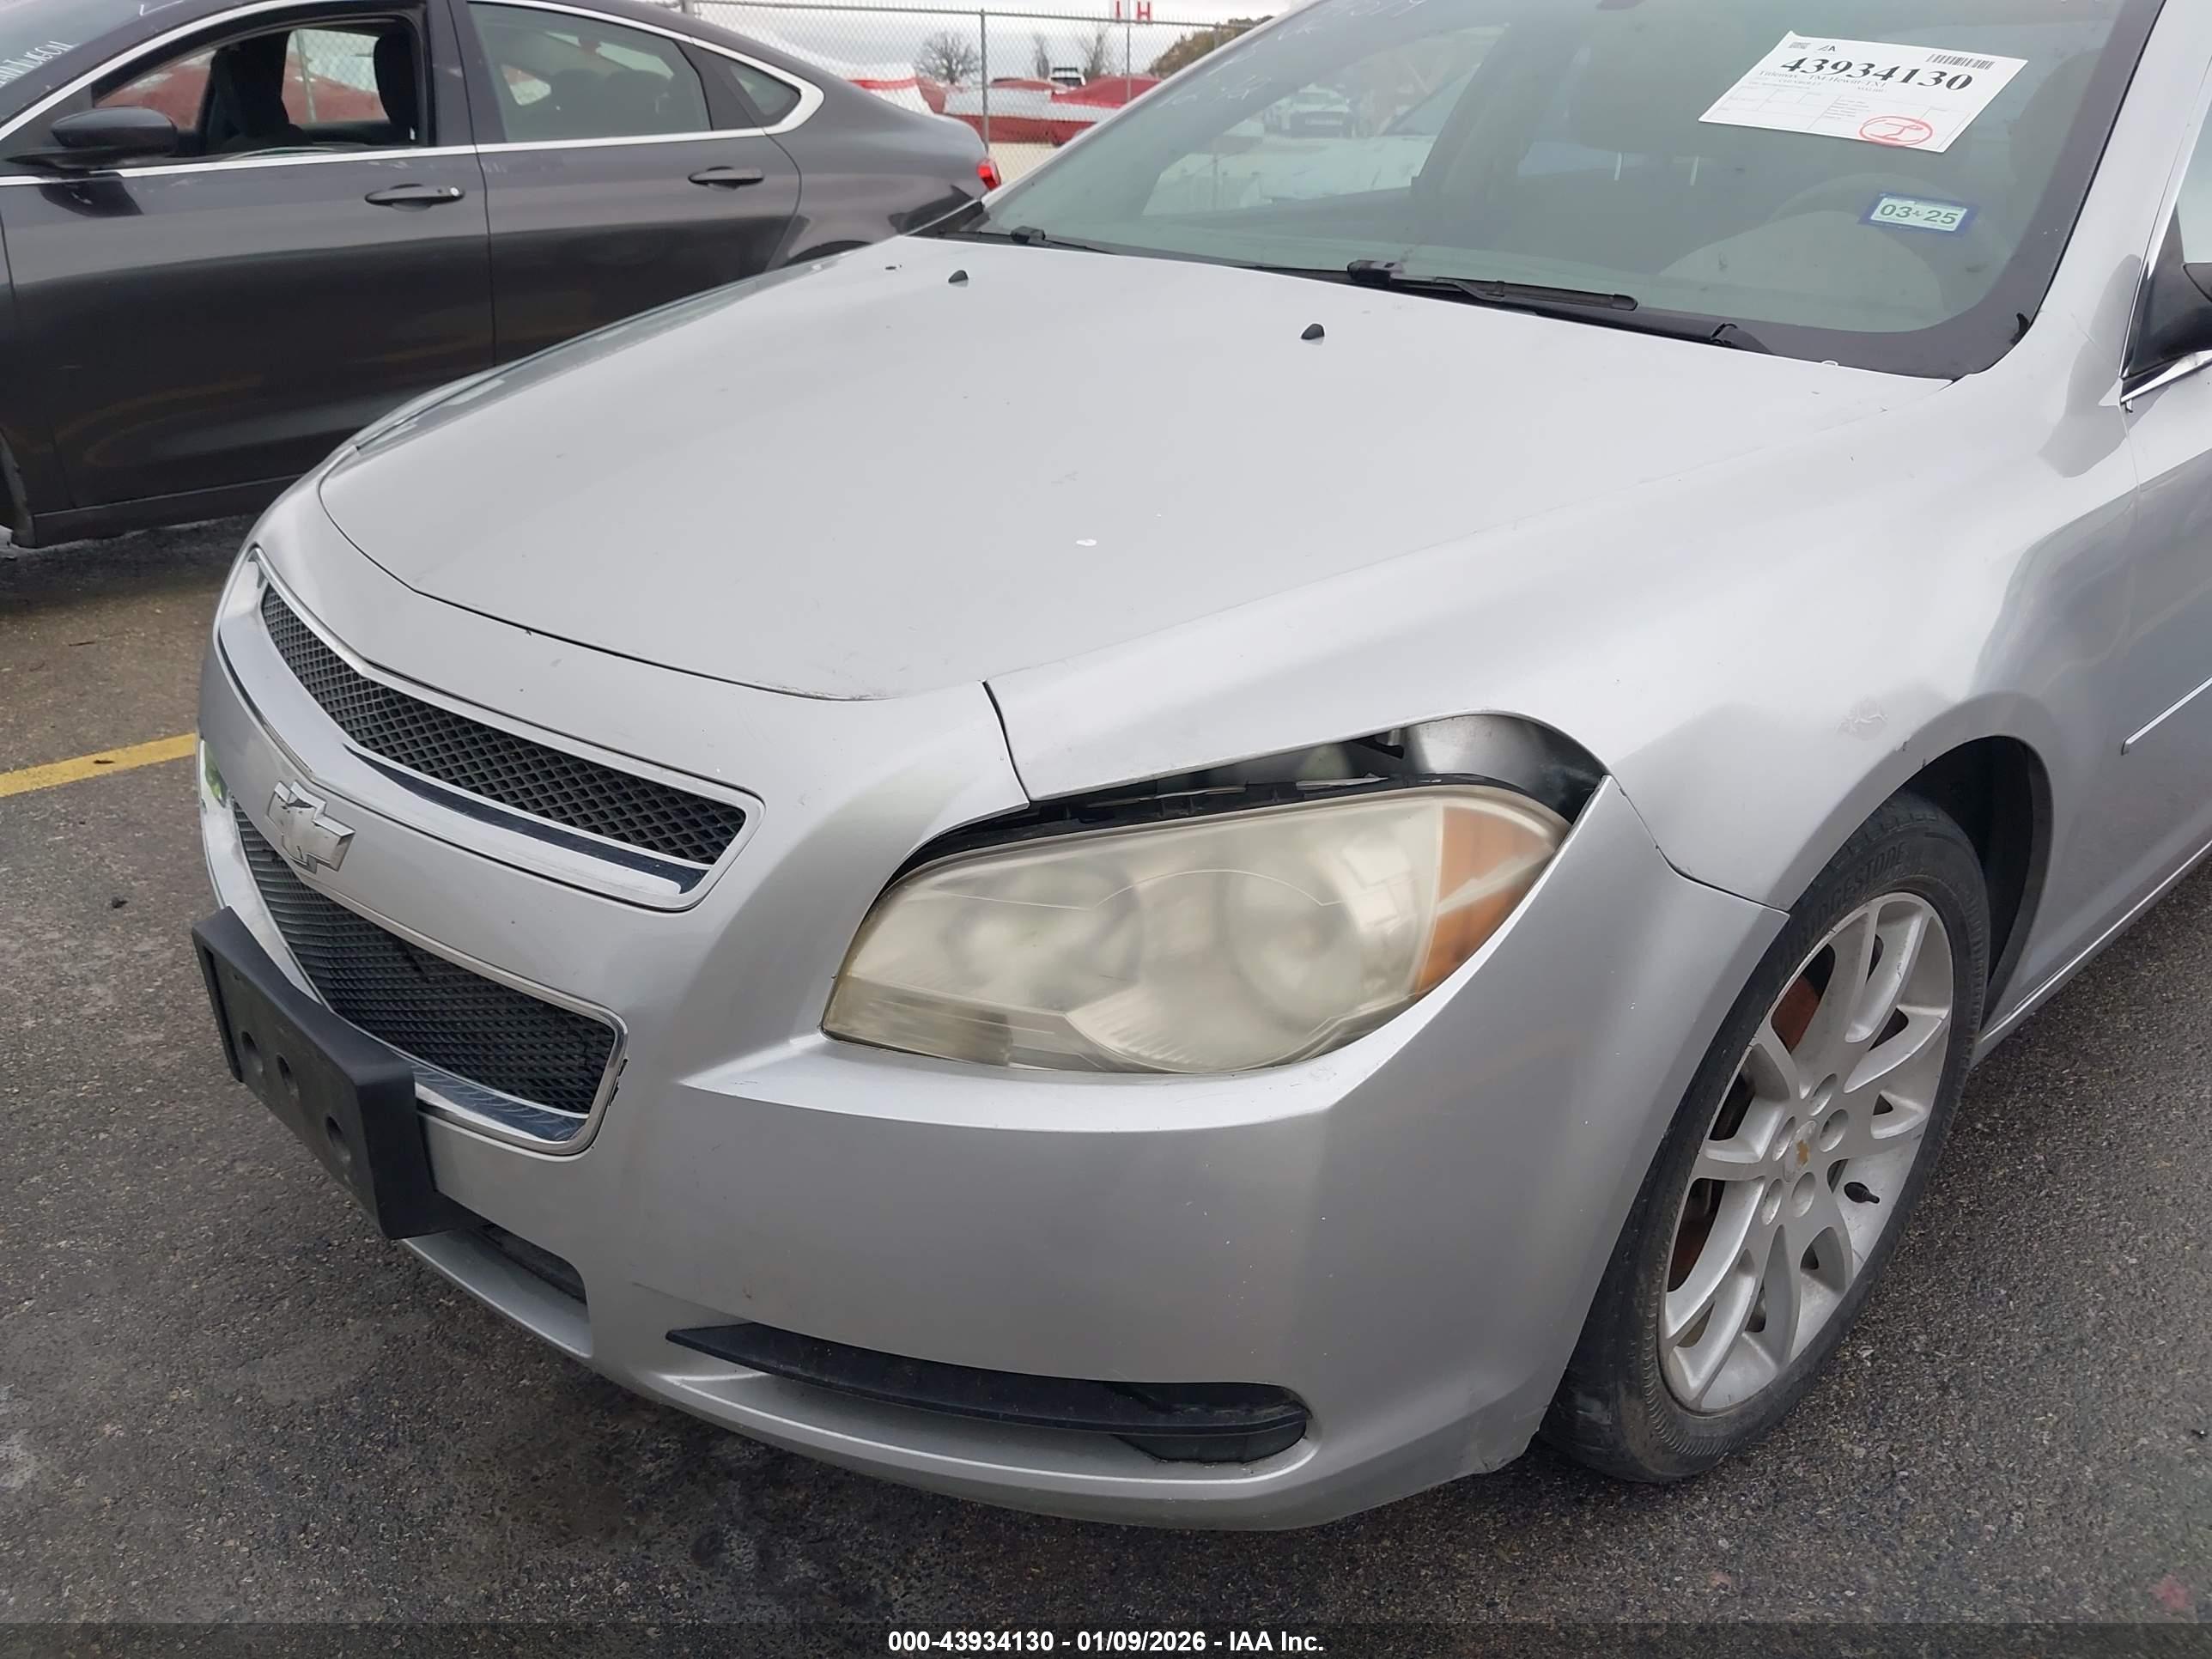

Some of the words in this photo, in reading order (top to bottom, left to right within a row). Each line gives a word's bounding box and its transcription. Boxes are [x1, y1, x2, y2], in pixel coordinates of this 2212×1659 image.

[1780, 57, 1973, 91] 43934130
[1880, 204, 1913, 218] 03
[1923, 210, 1959, 225] 25
